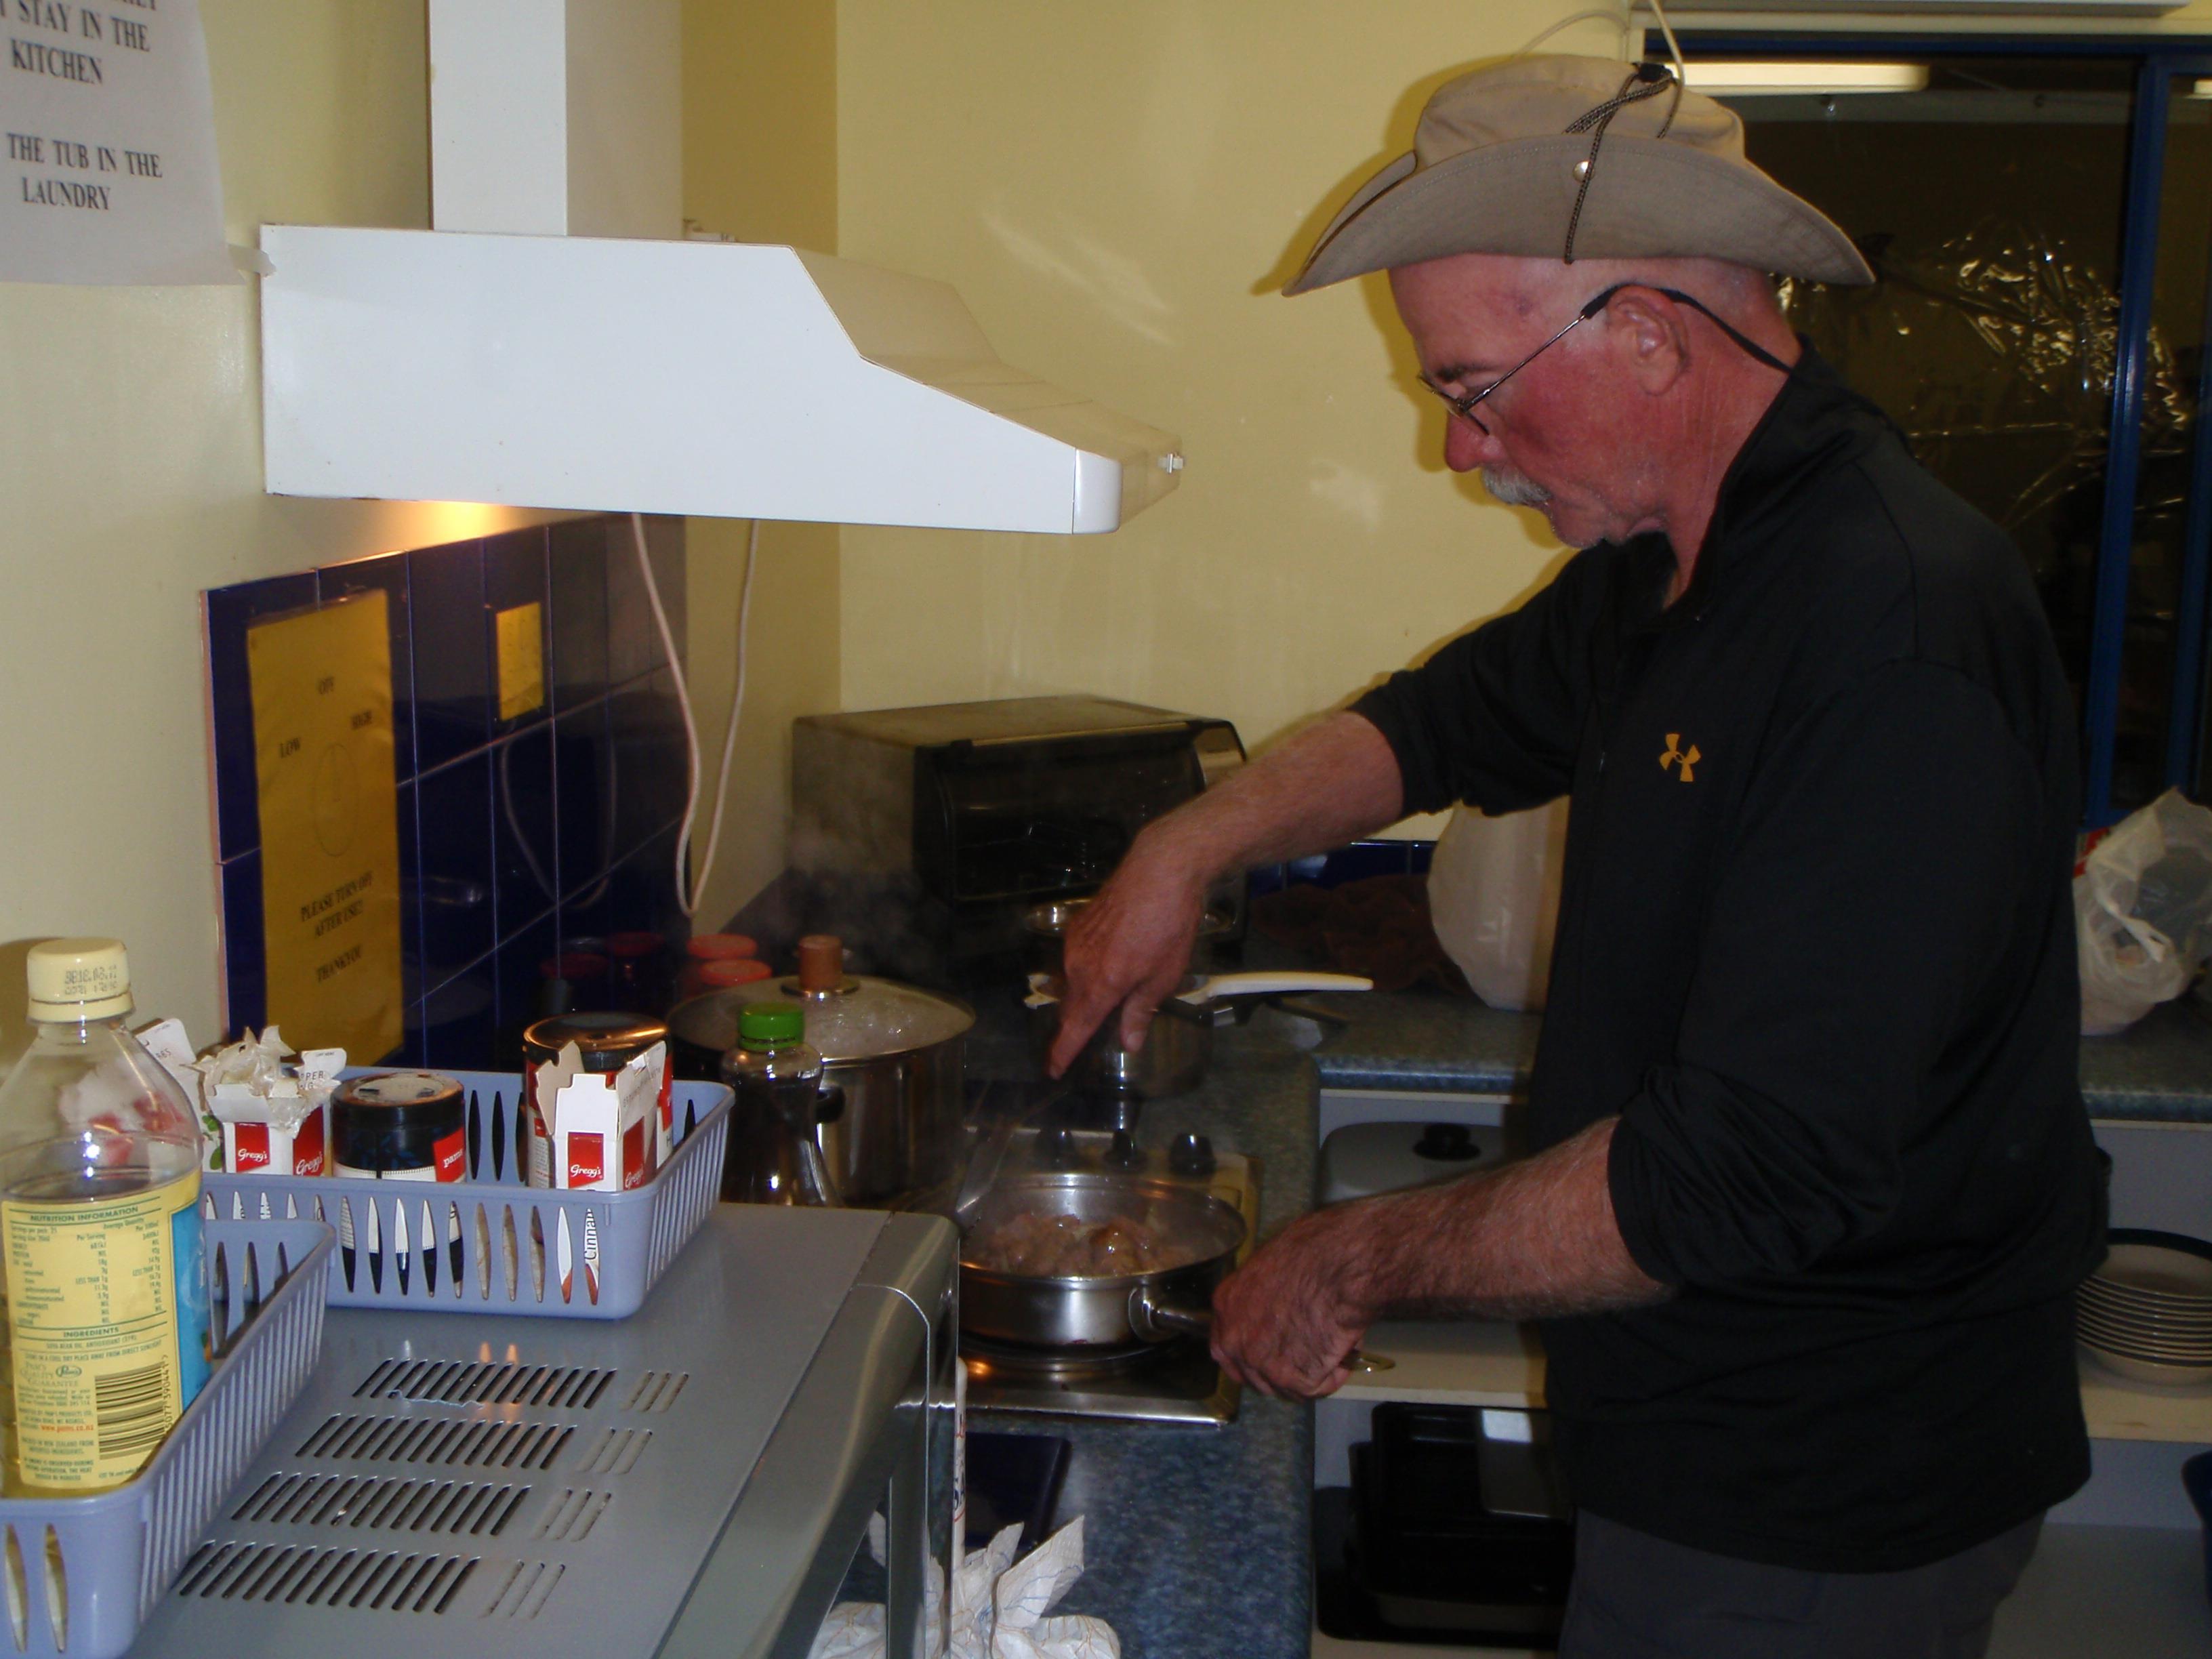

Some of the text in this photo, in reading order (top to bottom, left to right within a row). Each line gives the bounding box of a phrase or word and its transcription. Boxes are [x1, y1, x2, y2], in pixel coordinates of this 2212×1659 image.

[19, 0, 70, 33] STAY
[81, 9, 103, 40] IN
[109, 16, 150, 52] THE
[11, 38, 103, 85] KITCHEN
[7, 133, 163, 178] THE TUB IN THE
[21, 177, 110, 210] LAUNDRY
[279, 737, 301, 758] LOW
[238, 1148, 268, 1162] Gregg's
[296, 1151, 323, 1176] Gregg's
[570, 1164, 602, 1178] Gregg's
[78, 1206, 138, 1221] INFORMATION
[64, 1327, 119, 1338] INGREDIENTS
